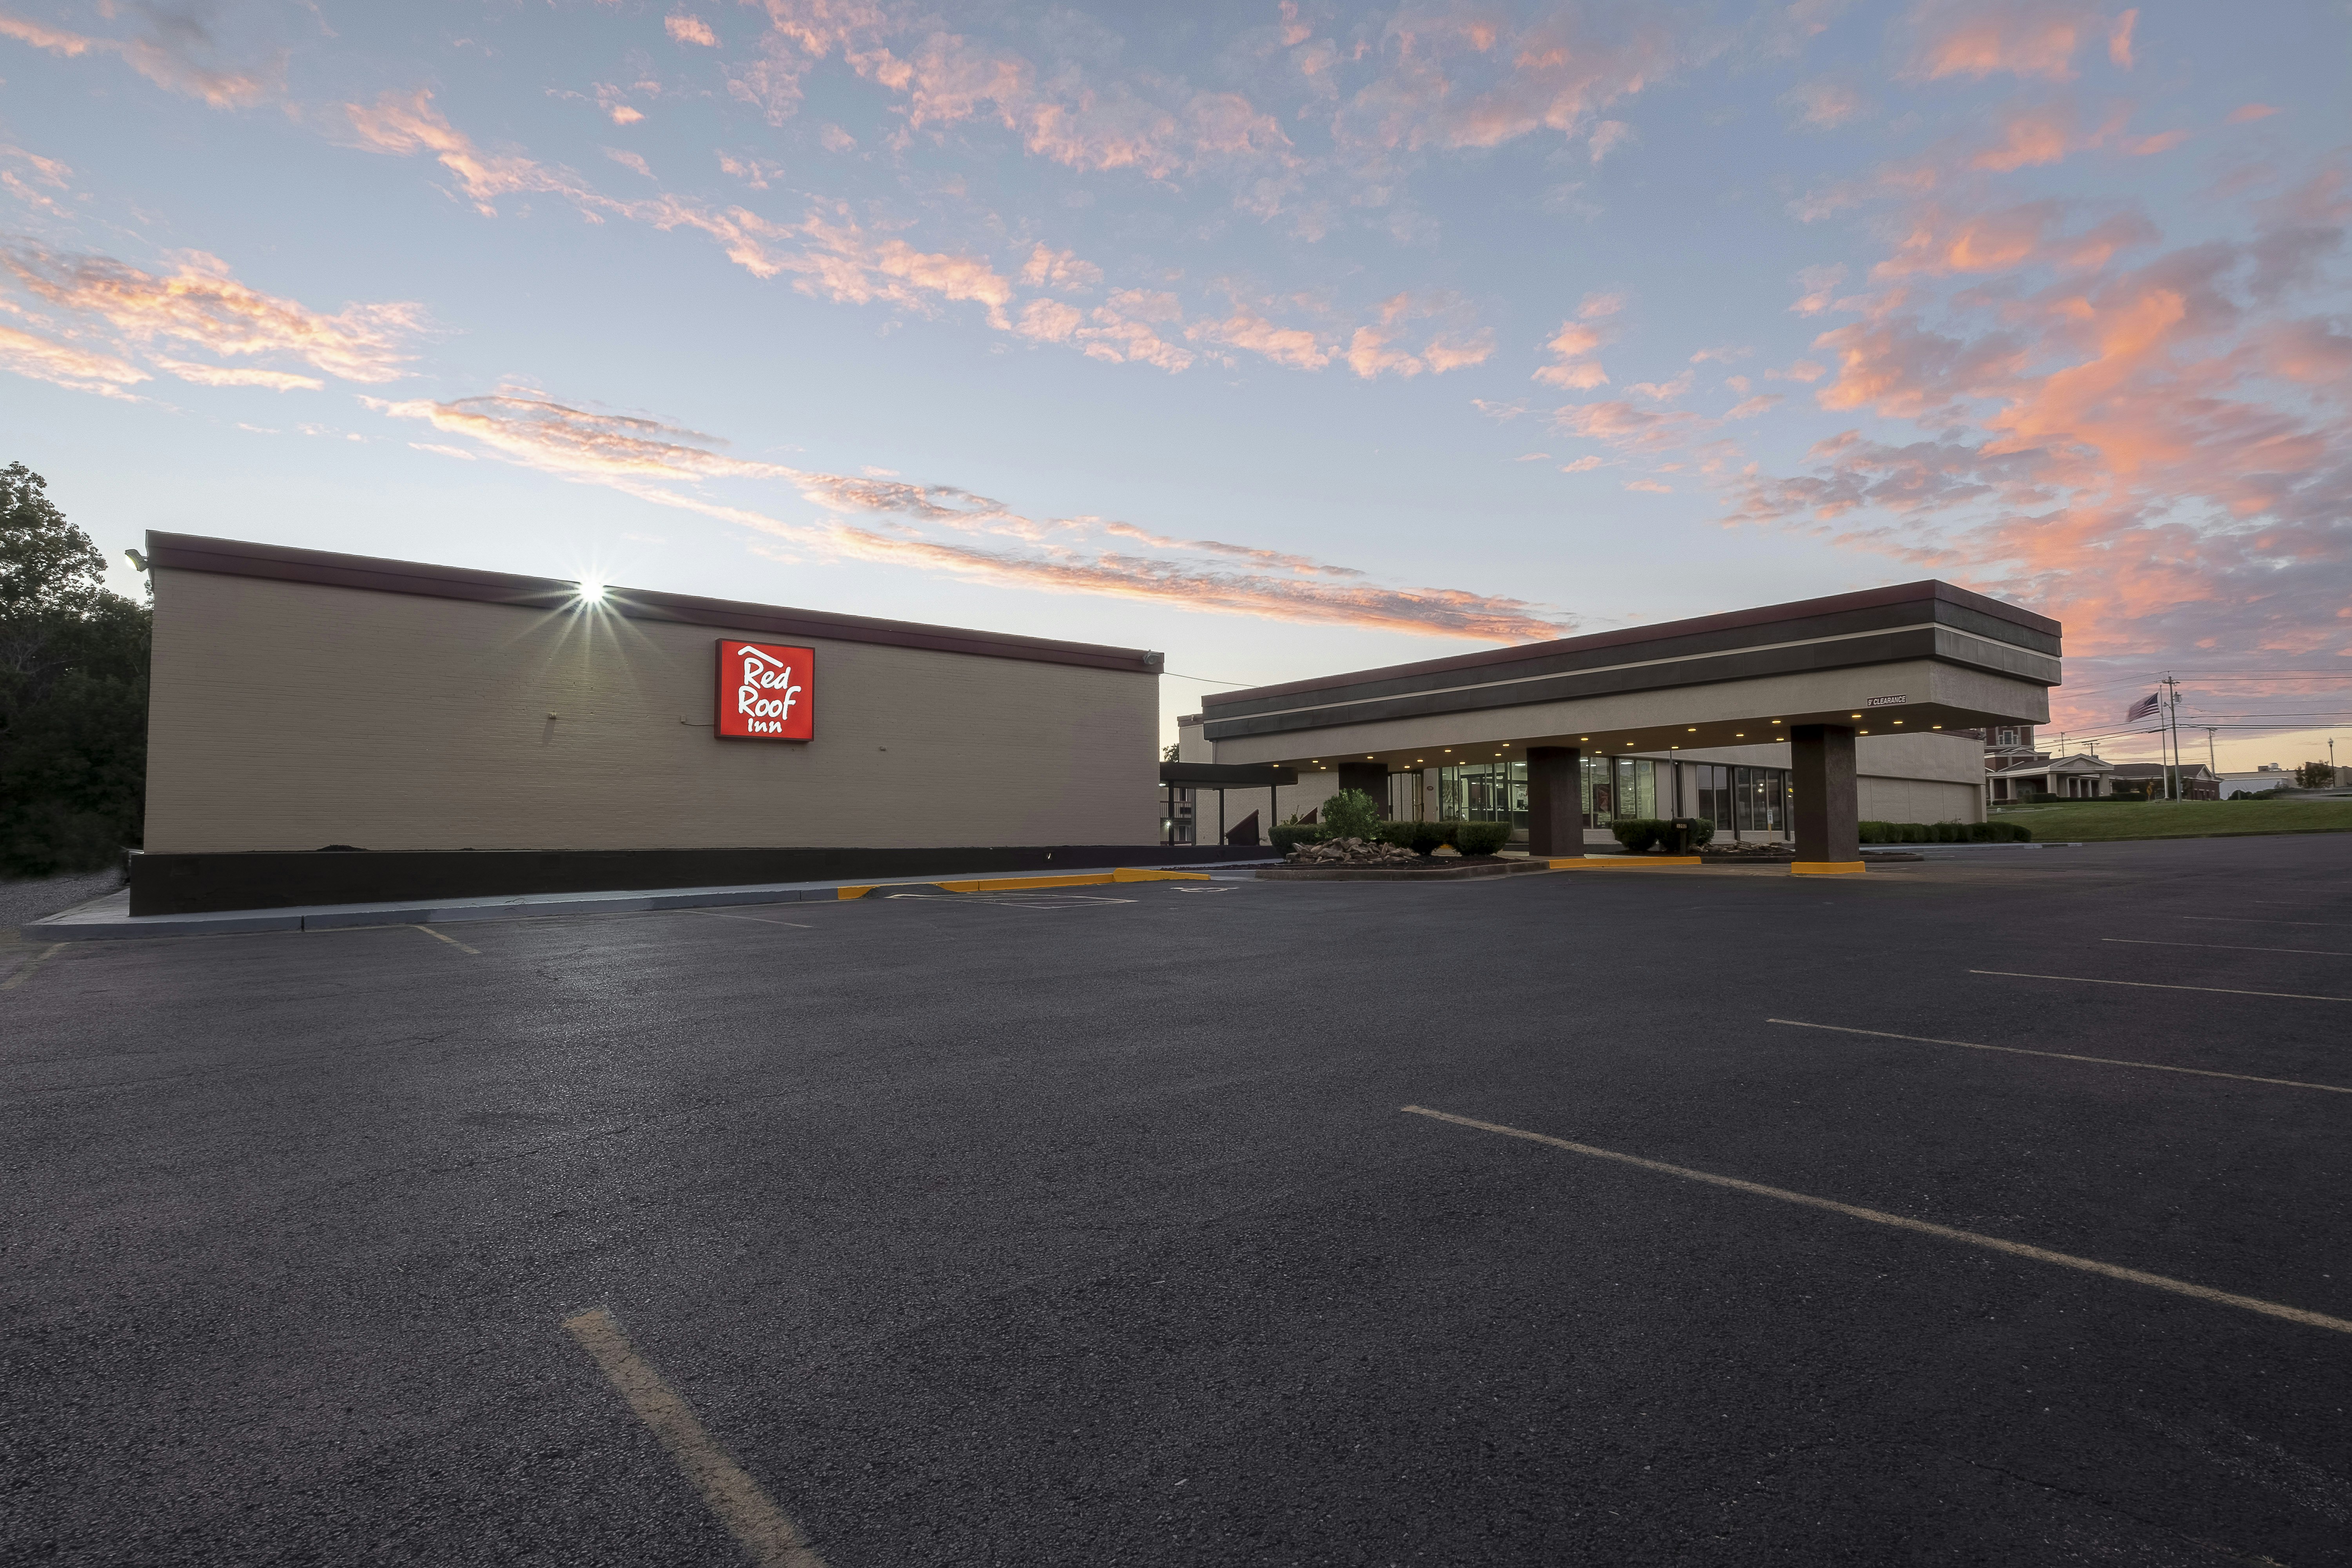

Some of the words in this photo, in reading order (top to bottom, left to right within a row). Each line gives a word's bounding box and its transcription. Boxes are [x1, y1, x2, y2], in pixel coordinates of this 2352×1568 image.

[744, 657, 791, 690] Red
[739, 685, 801, 720] Roof
[1873, 696, 1906, 705] CLEARANCE
